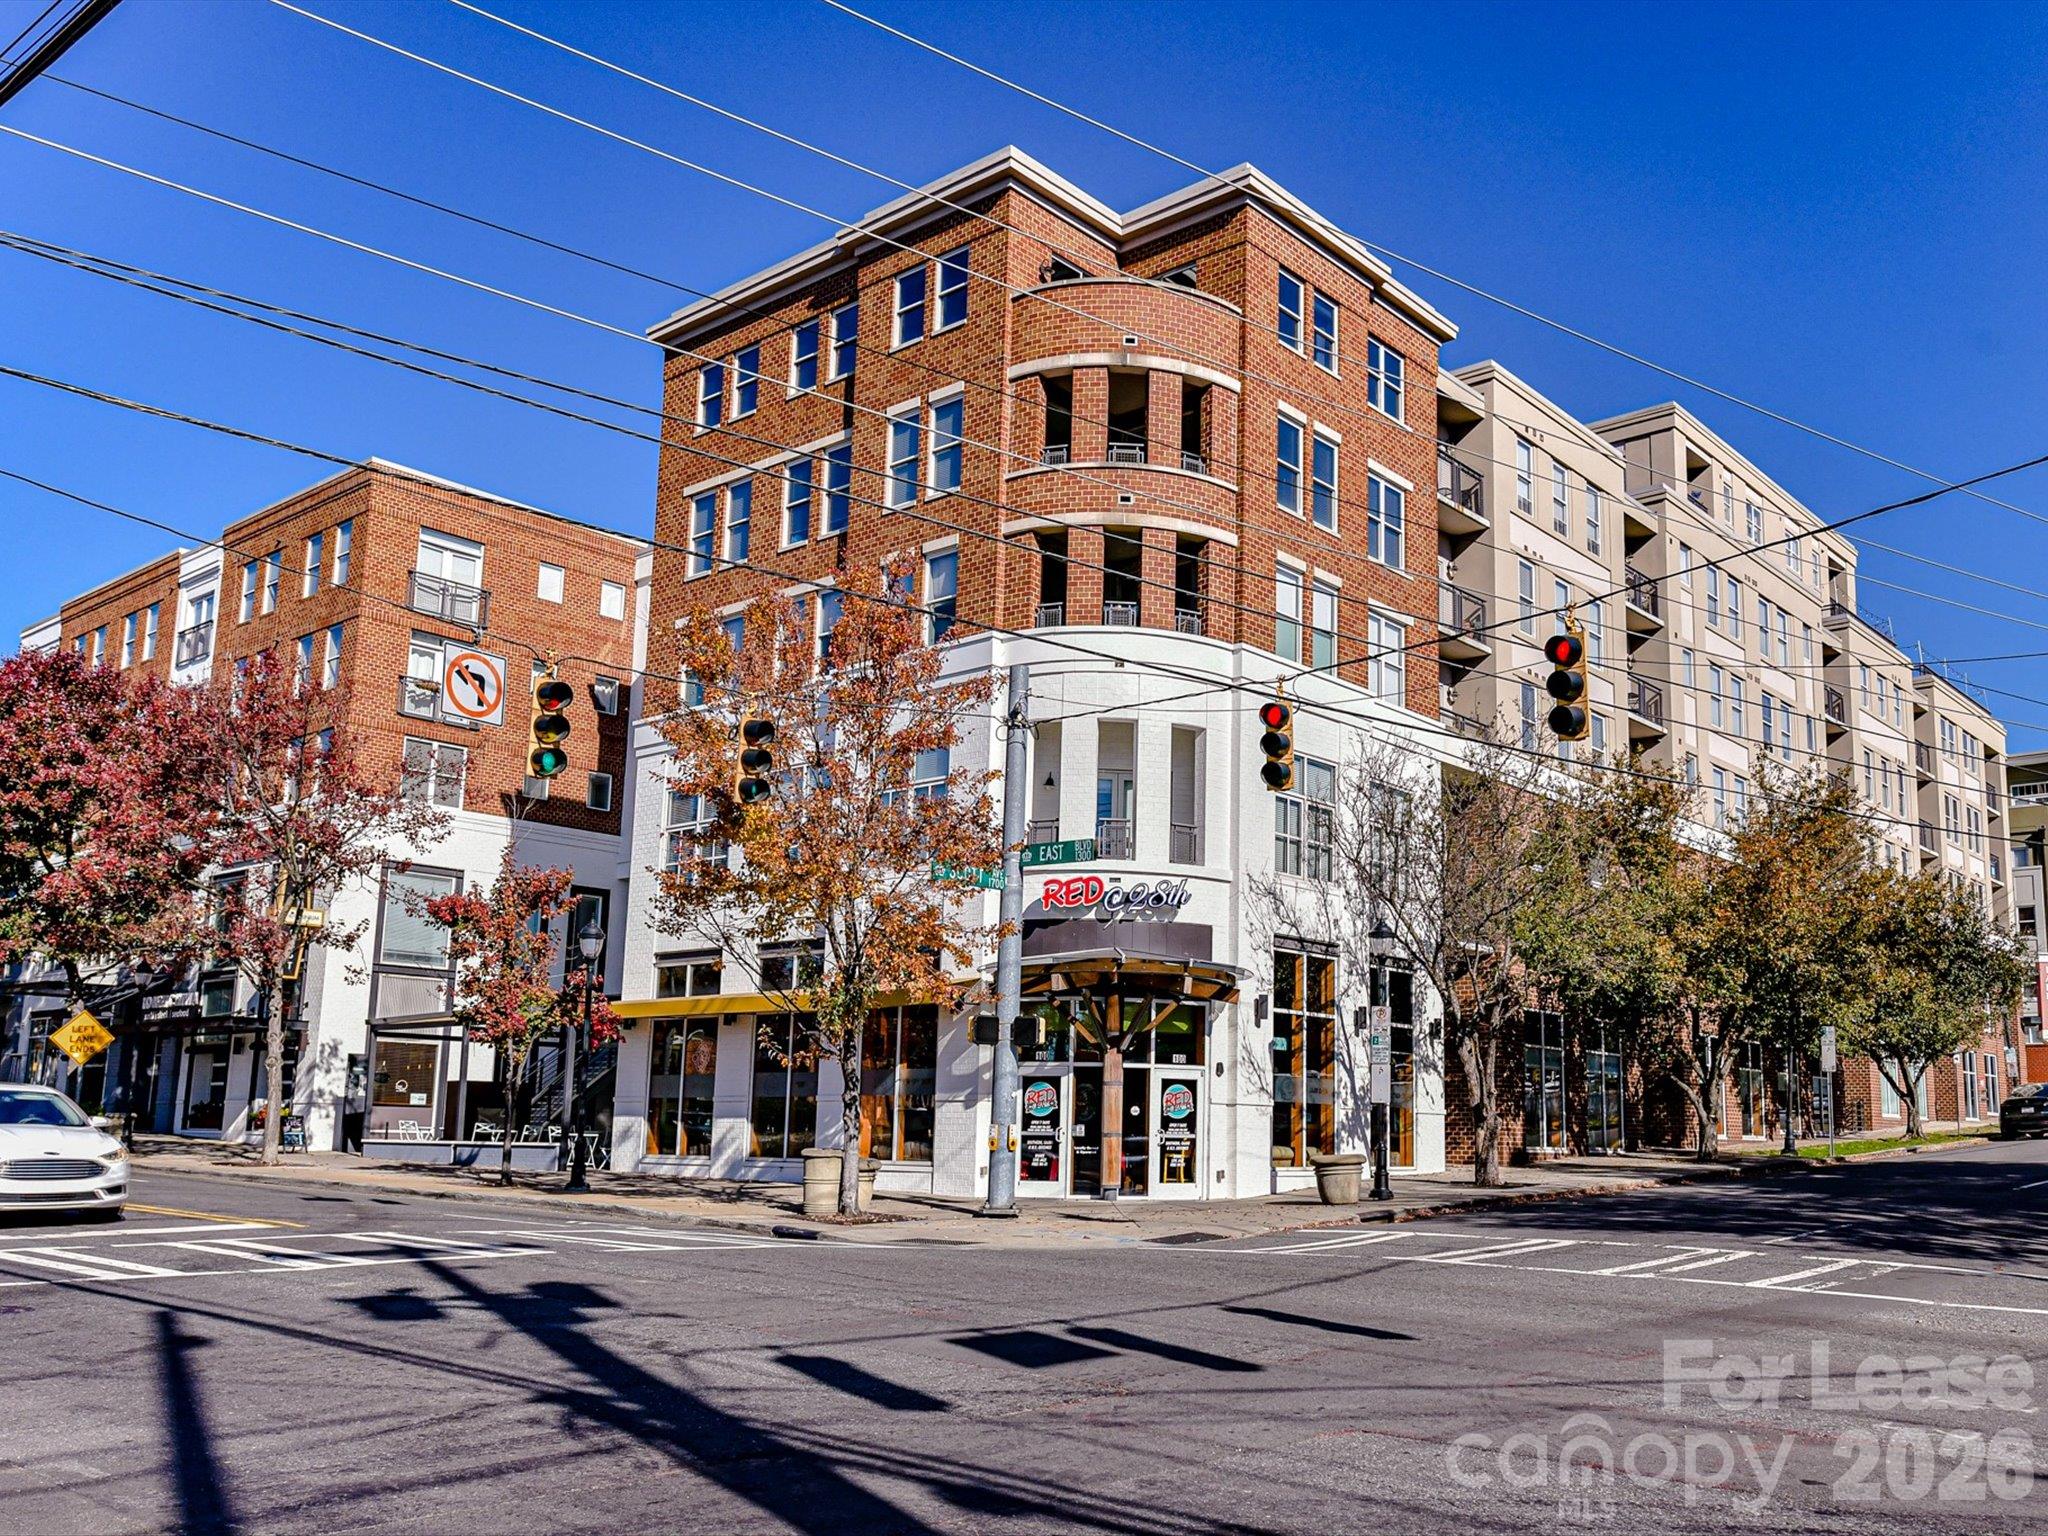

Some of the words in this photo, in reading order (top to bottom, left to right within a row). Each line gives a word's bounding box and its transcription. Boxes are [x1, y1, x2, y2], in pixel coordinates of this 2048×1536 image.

[1075, 840, 1092, 851] BLVD
[1039, 844, 1064, 861] EAST
[1075, 850, 1092, 861] 1300
[992, 866, 1005, 880] AVE
[988, 877, 1005, 889] 1700
[1041, 876, 1104, 911] RED
[71, 1025, 95, 1033] LEFT
[69, 1035, 96, 1043] LANE
[69, 1045, 96, 1053] ENDS
[1026, 1088, 1056, 1104] RED
[1164, 1091, 1192, 1106] RED
